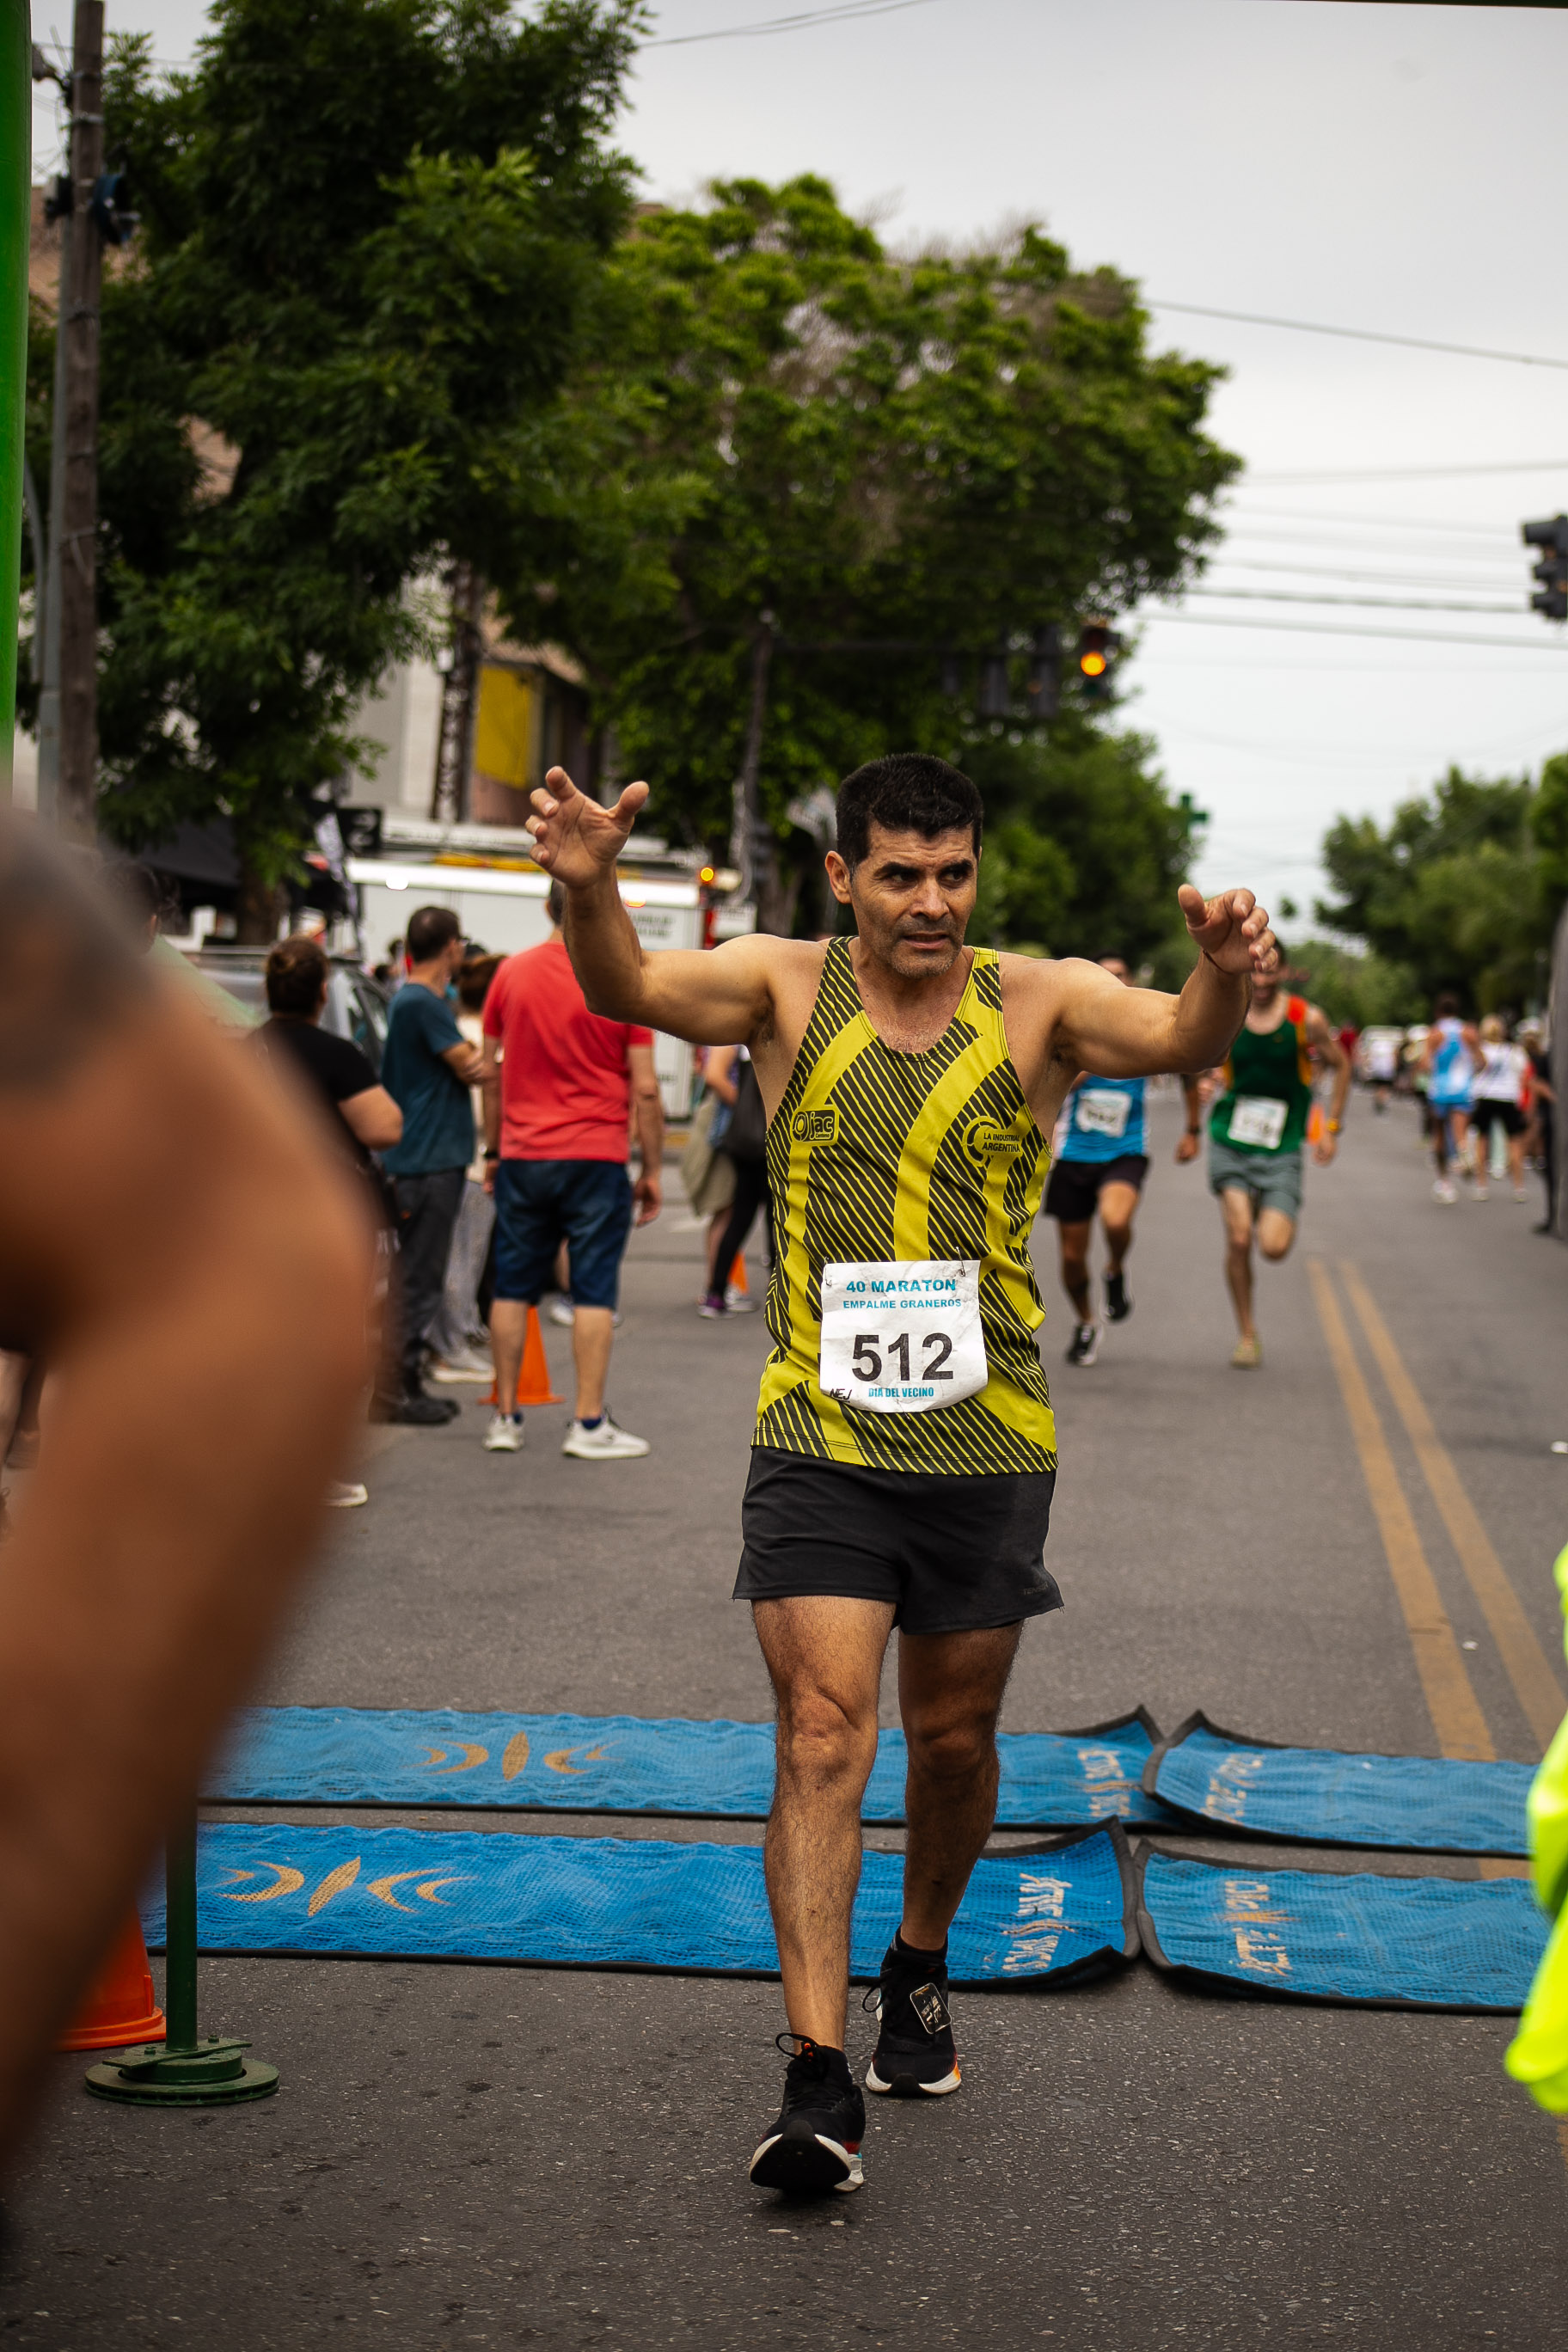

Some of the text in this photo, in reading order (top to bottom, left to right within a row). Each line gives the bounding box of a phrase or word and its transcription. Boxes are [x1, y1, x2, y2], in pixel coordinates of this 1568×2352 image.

[983, 1132, 992, 1141] LA
[981, 1142, 1021, 1153] ARGENTINA
[846, 1279, 956, 1292] 40 MARATON
[842, 1298, 962, 1308] EMPALME GRANEROS
[851, 1332, 953, 1381] 512
[886, 1387, 901, 1397] DEL
[903, 1387, 934, 1398] VECINO
